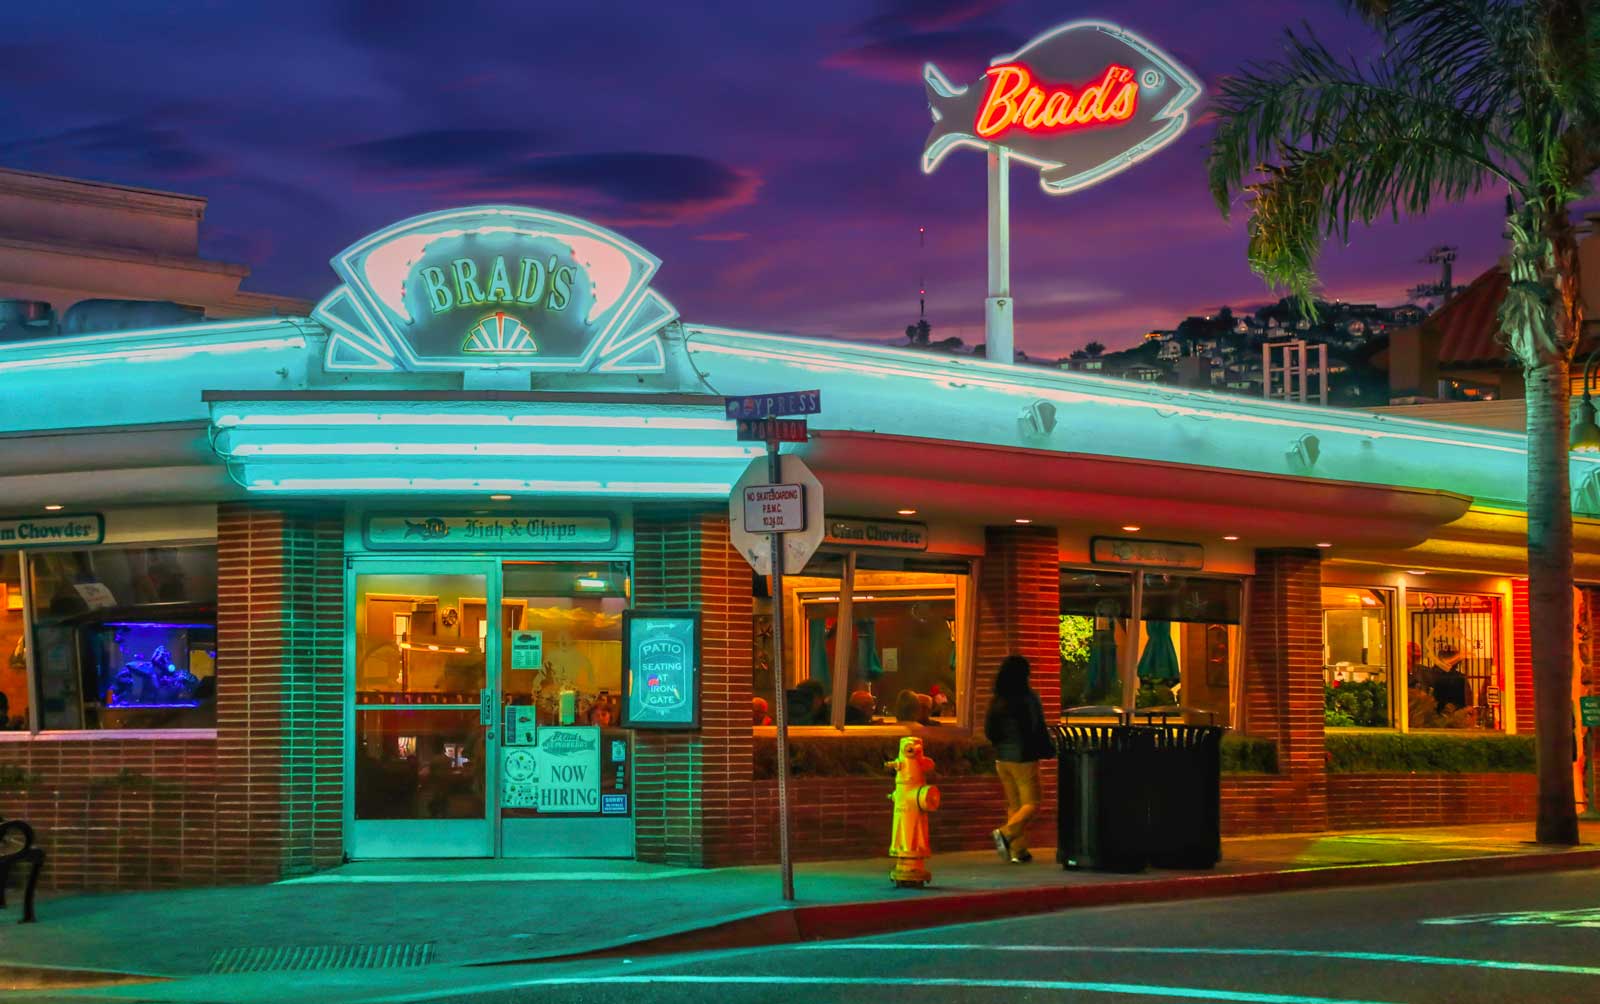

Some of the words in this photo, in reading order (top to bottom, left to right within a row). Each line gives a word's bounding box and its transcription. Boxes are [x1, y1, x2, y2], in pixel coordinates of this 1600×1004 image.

[976, 65, 1139, 136] Brad's
[420, 255, 577, 314] BRAD'S
[747, 491, 755, 502] NO
[756, 489, 798, 501] SKATEBOARDING
[17, 522, 92, 540] Chowder
[463, 519, 504, 540] Fish
[509, 519, 522, 537] &
[526, 519, 577, 541] Chips
[866, 525, 920, 544] Chowder
[642, 642, 682, 656] PATIO
[642, 662, 682, 671] SEATING
[650, 685, 675, 693] IRON
[649, 695, 676, 705] GATE
[551, 765, 588, 783] NOW
[541, 788, 598, 807] HIRING
